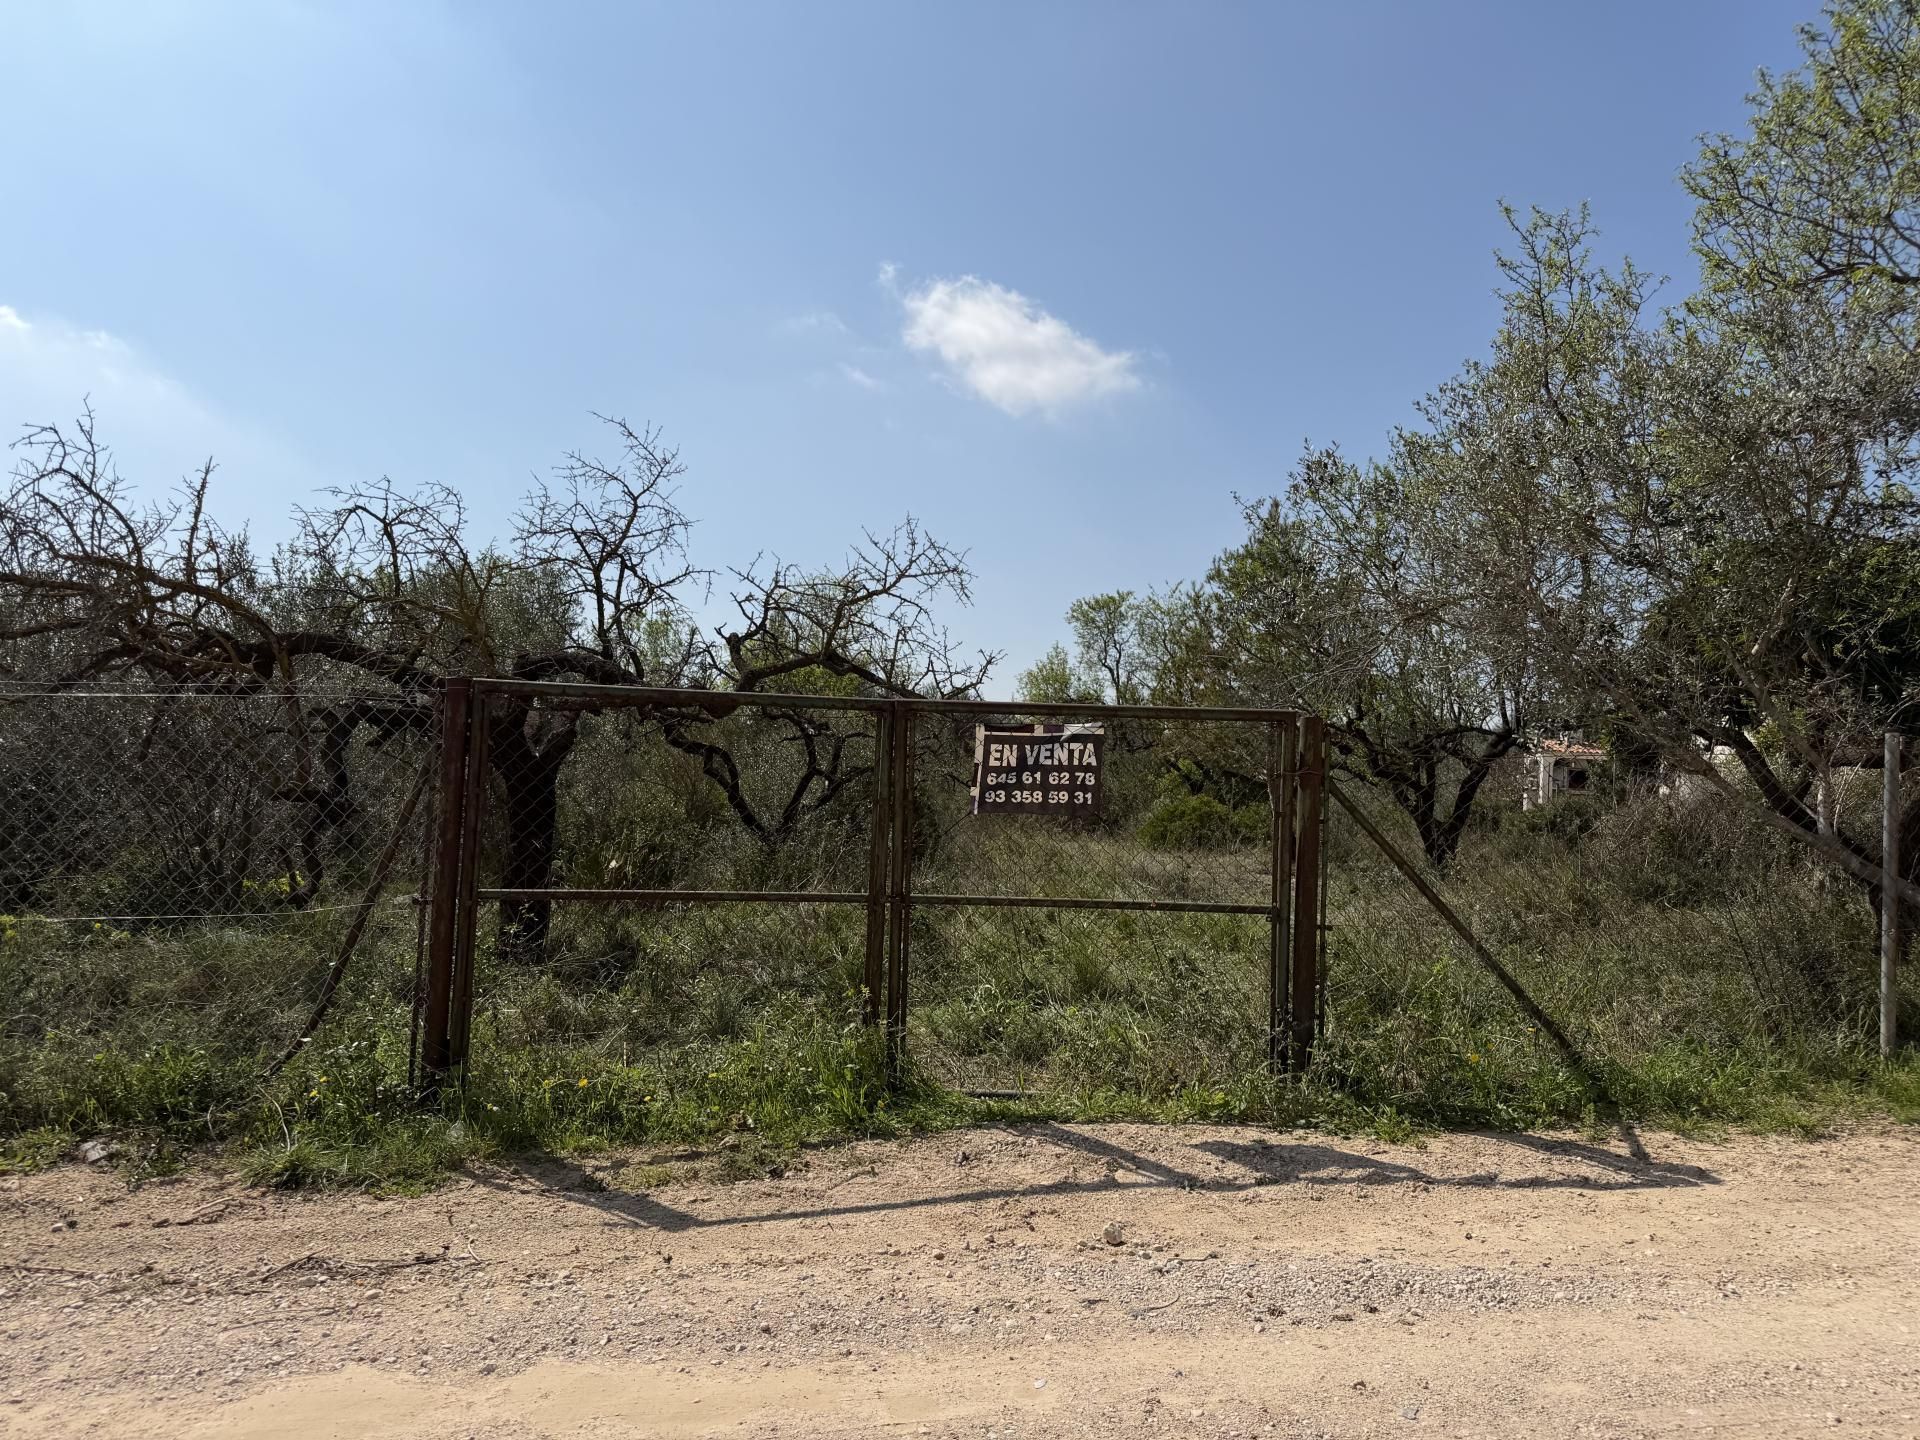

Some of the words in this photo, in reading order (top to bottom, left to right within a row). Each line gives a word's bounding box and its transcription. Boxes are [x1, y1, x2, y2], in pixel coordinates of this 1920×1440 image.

[988, 743, 1018, 767] EN
[1024, 742, 1097, 766] VENTA
[986, 771, 1017, 785] 645
[1022, 771, 1041, 784] 61
[1048, 771, 1070, 785] 62
[1074, 772, 1096, 786] 78
[984, 790, 1006, 803] 93
[1011, 790, 1043, 804] 358
[1047, 791, 1069, 804] 59
[1073, 791, 1093, 805] 31
